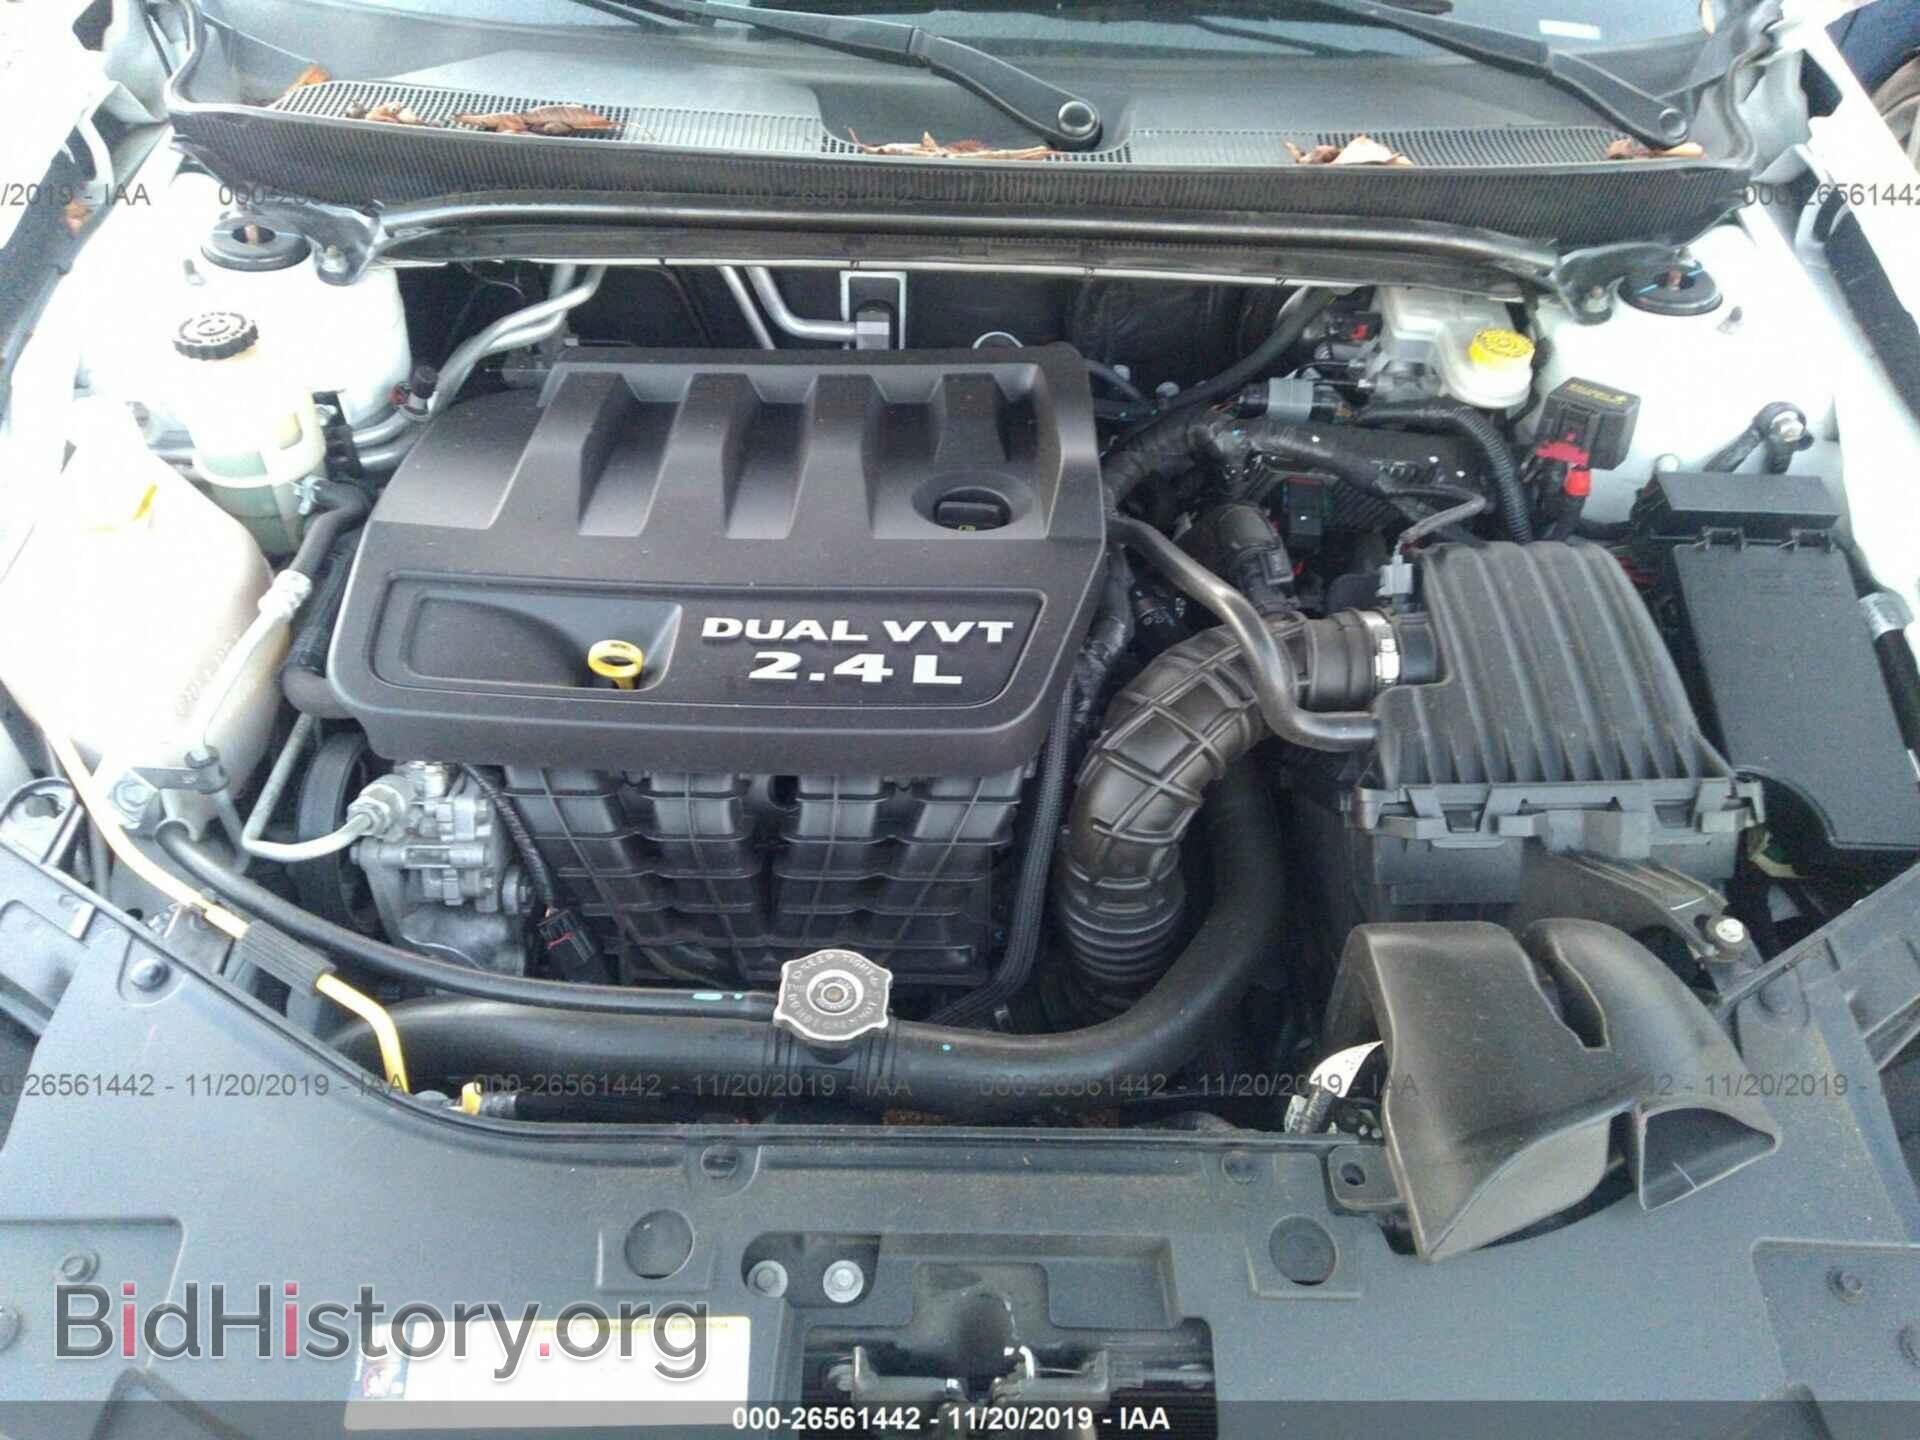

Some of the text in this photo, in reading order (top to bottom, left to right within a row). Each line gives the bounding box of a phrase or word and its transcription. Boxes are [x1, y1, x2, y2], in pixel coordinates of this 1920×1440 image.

[702, 617, 1014, 643] DUAL VVT
[748, 651, 894, 683] 2.4
